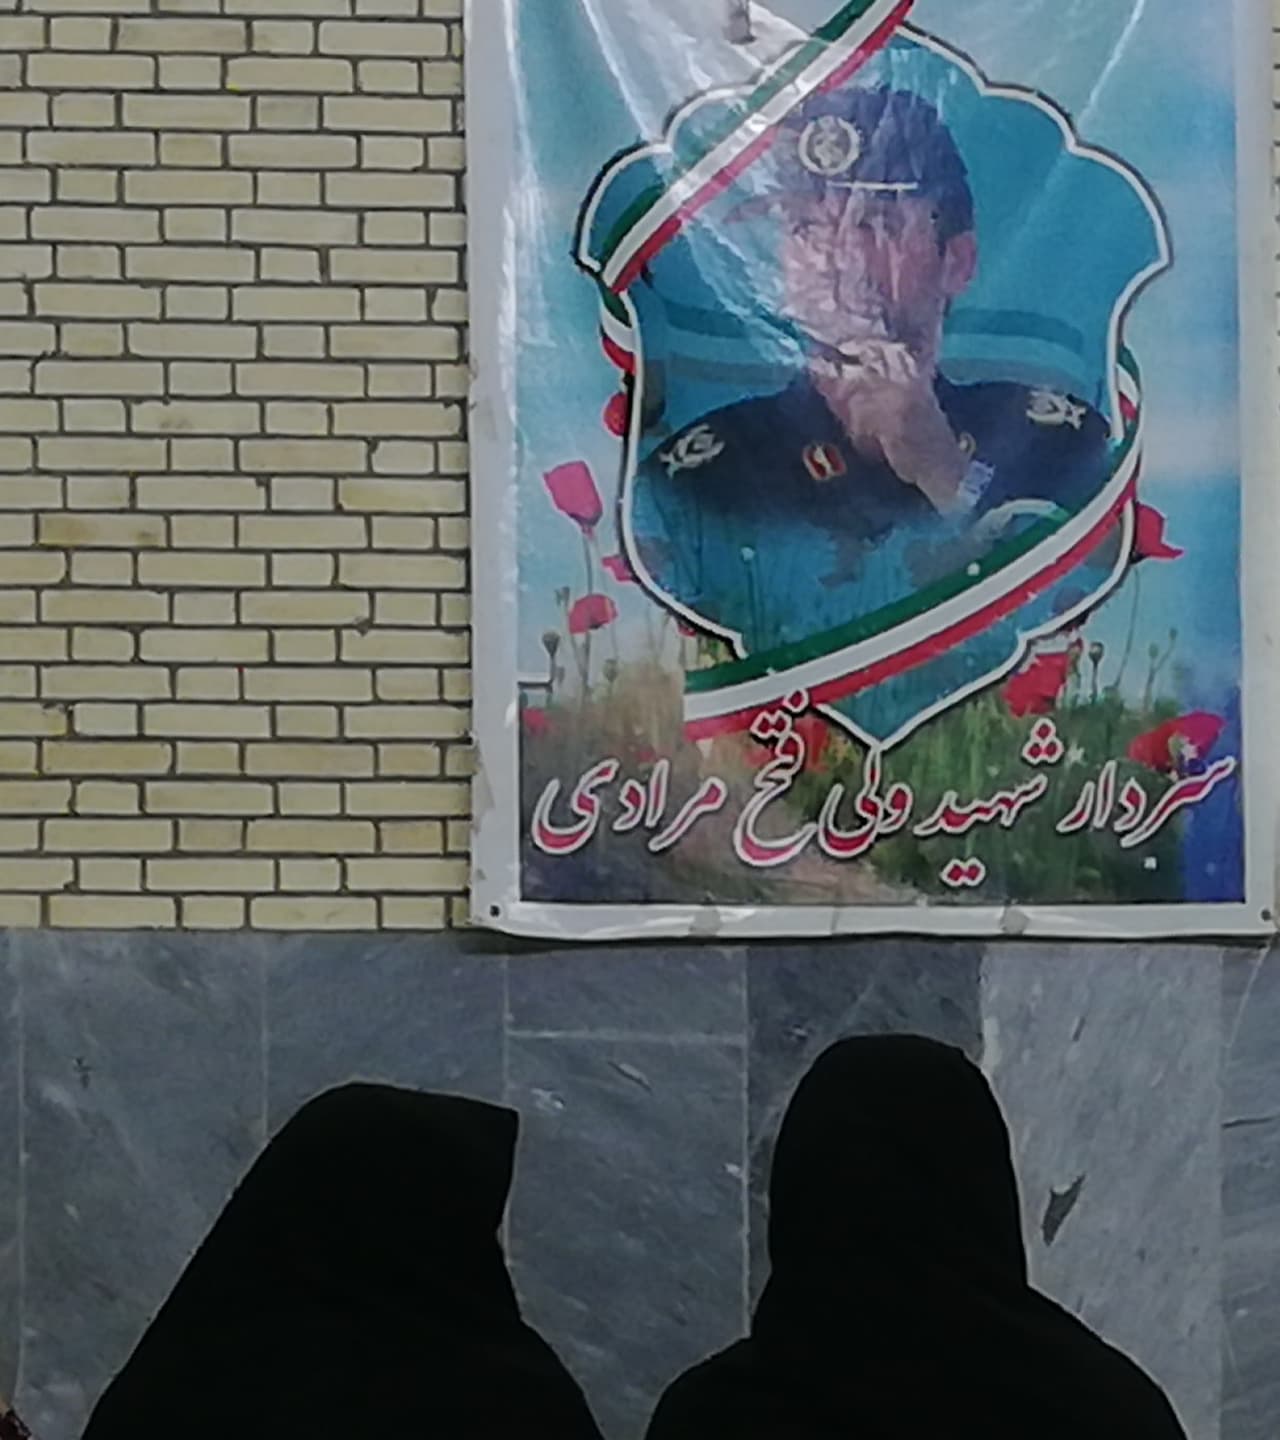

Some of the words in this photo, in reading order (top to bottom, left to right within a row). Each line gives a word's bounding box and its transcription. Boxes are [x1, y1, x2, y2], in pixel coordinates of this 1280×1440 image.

[531, 757, 727, 856] مرادی
[817, 742, 911, 858] ولی
[913, 716, 1063, 887] شهید
[1056, 753, 1237, 847] سردار
